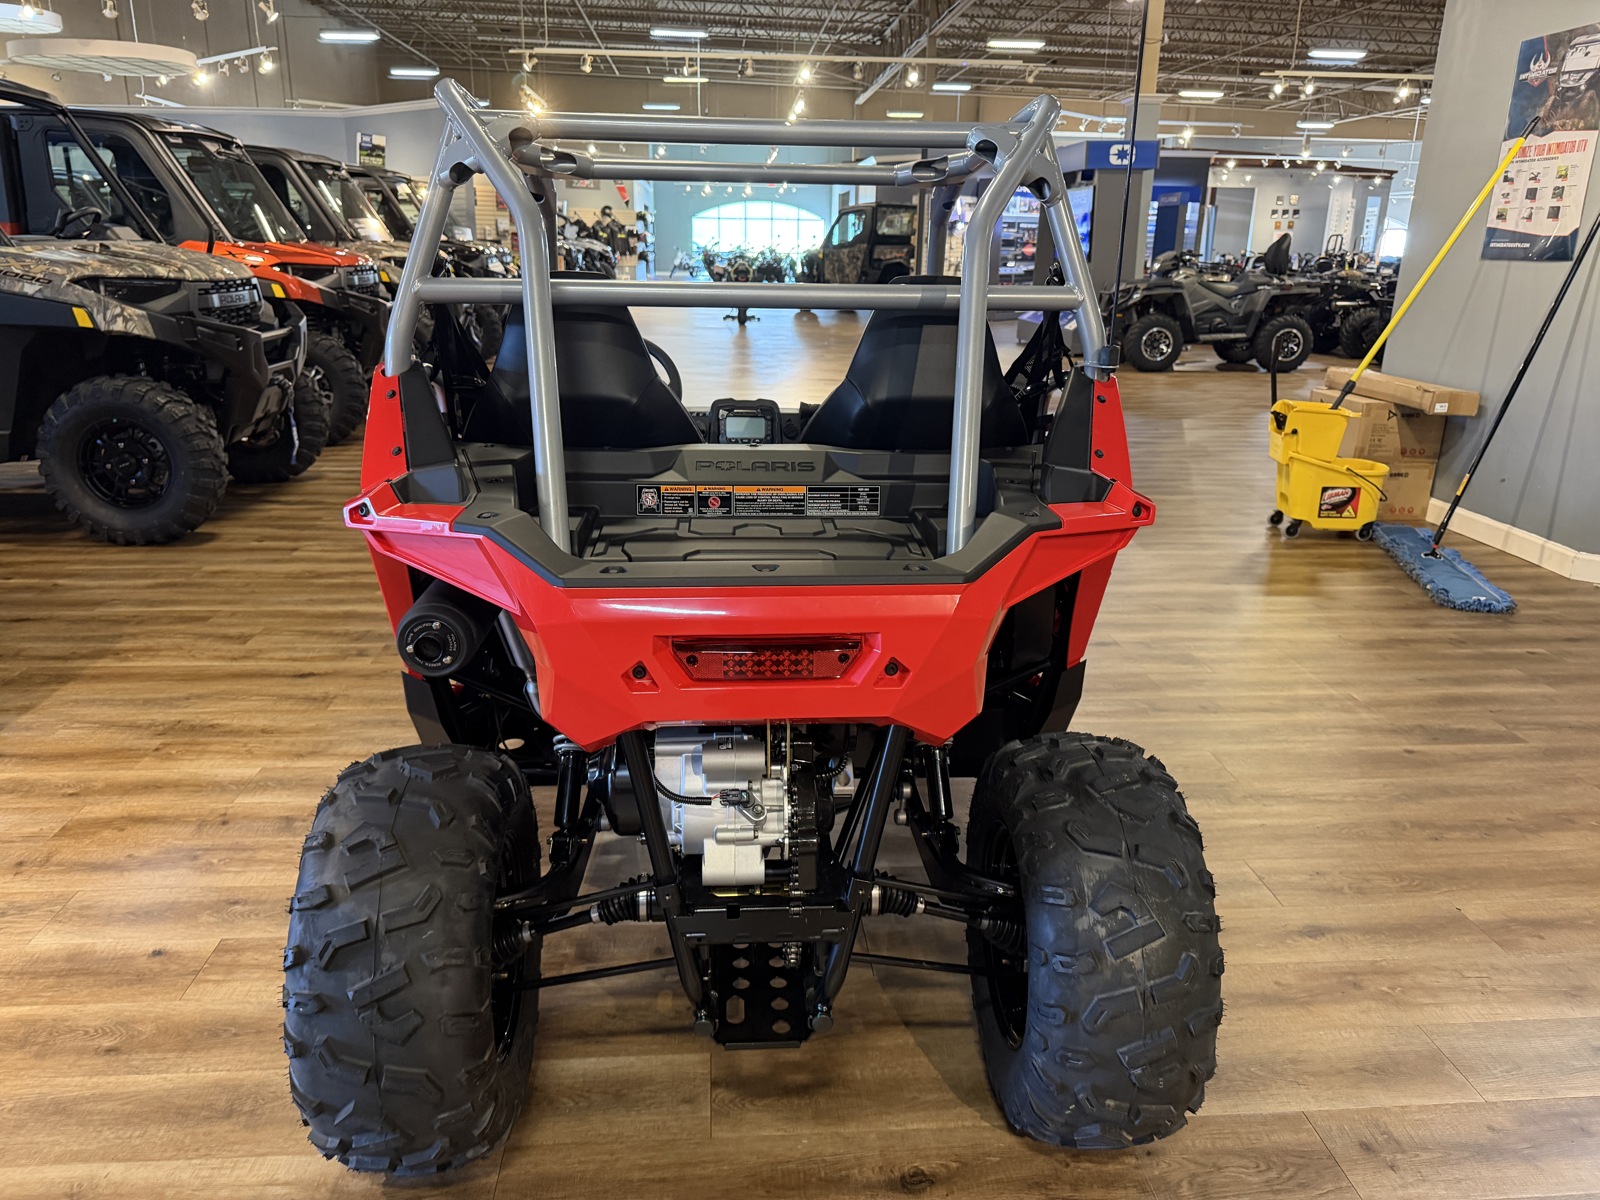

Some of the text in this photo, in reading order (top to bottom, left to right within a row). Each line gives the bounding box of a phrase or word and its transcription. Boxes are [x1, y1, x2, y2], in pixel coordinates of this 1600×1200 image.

[1534, 143, 1546, 157] YOUR
[1546, 140, 1577, 156] INTIMIDATOR
[1576, 139, 1589, 153] UTV
[0, 270, 53, 284] 000
[695, 460, 816, 472] POLARIS
[1322, 490, 1348, 502] LIBMAN
